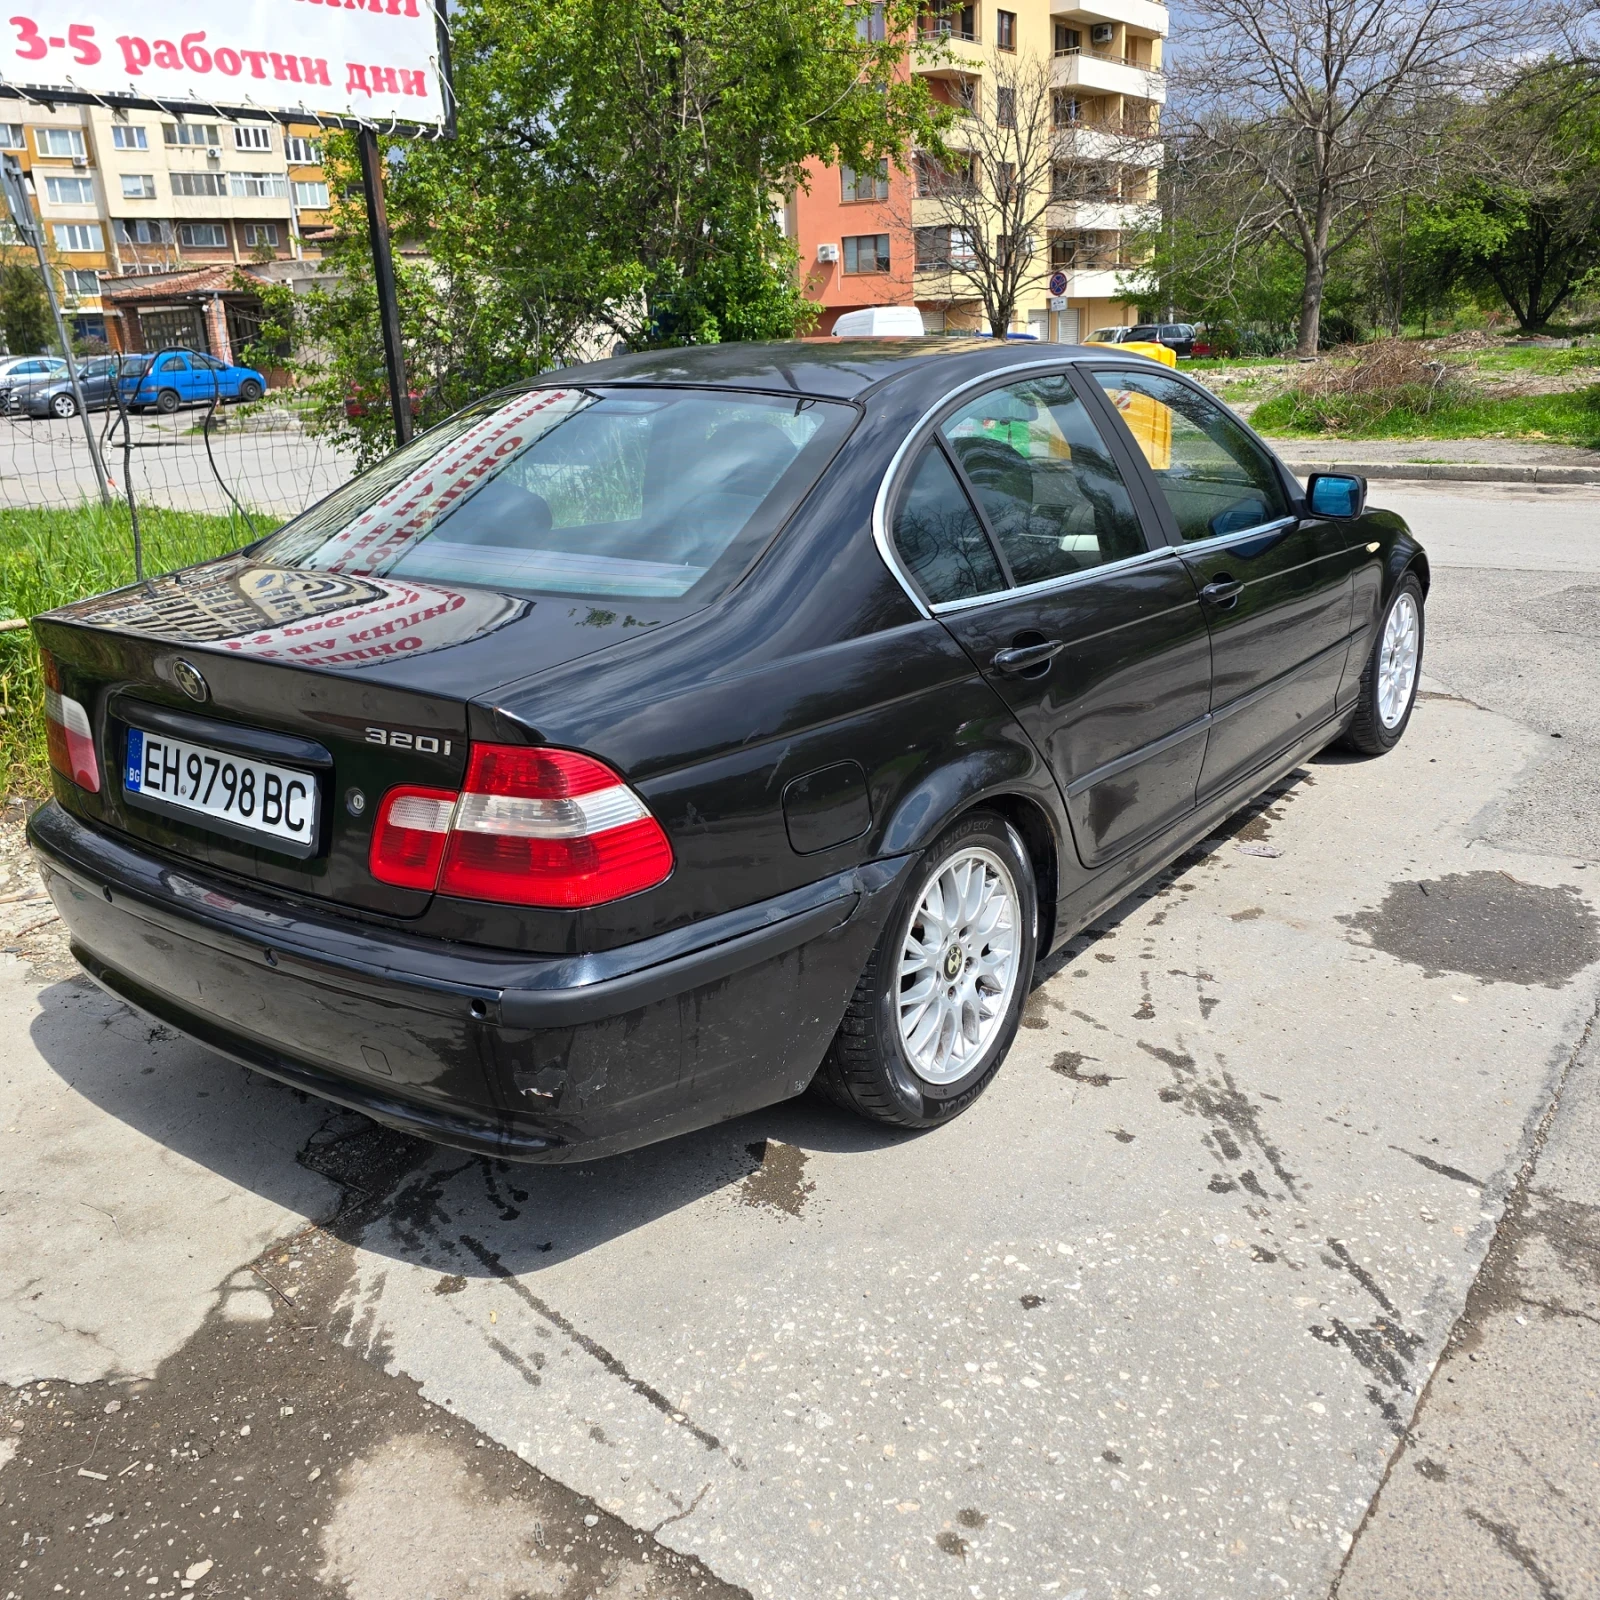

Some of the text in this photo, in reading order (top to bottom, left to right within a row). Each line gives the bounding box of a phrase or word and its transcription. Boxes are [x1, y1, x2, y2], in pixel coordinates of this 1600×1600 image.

[9, 16, 428, 98] 3-5 работни дни
[128, 767, 140, 783] BG
[144, 741, 307, 832] EH 9798 BC
